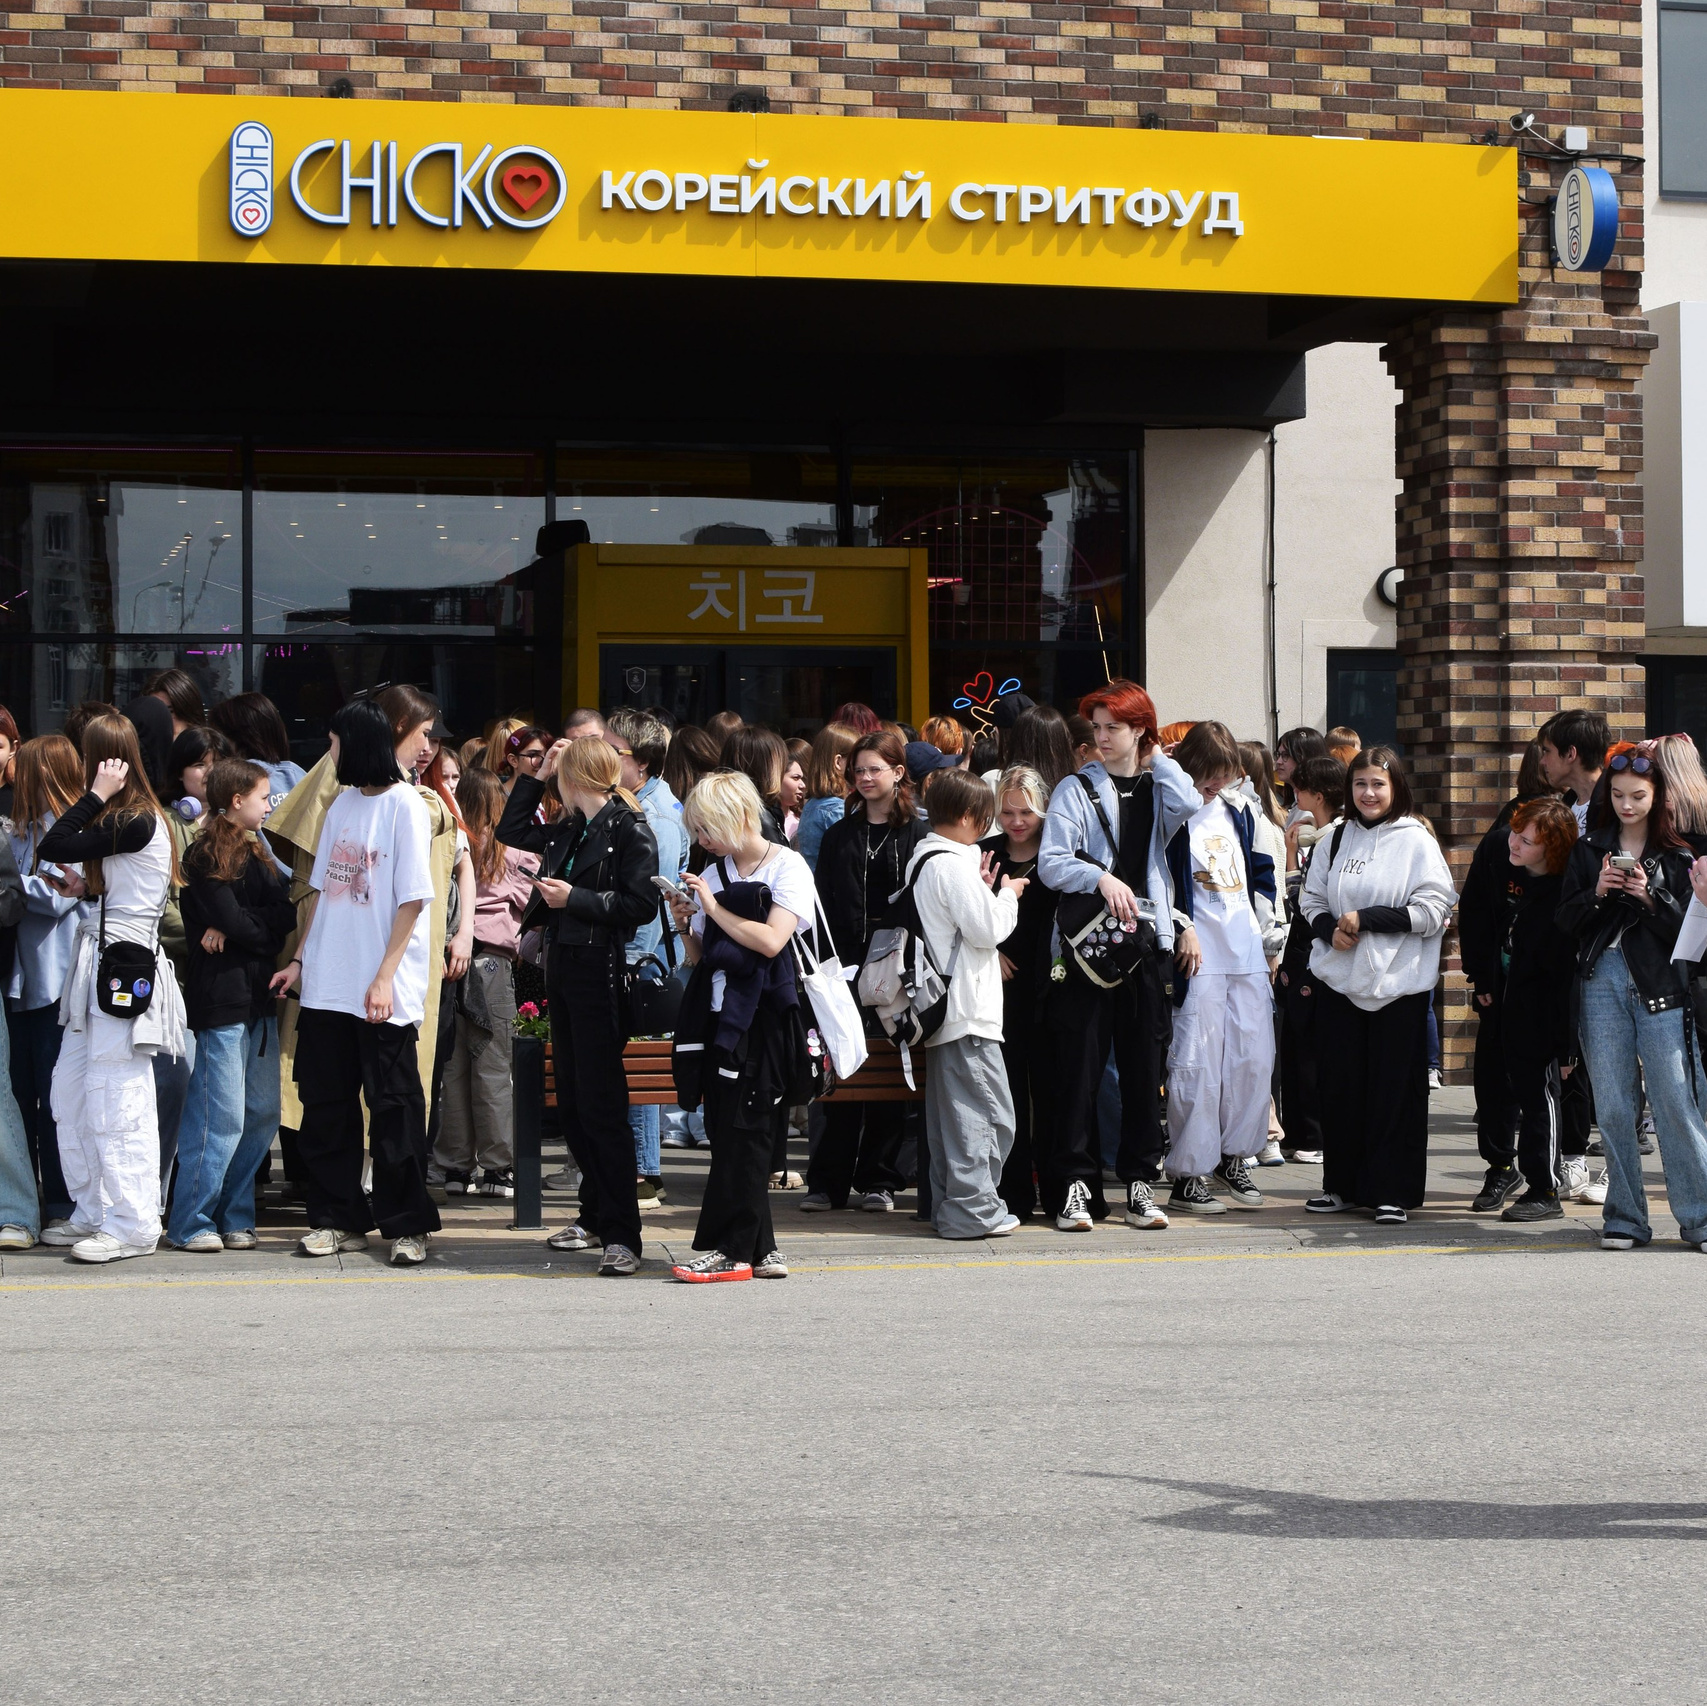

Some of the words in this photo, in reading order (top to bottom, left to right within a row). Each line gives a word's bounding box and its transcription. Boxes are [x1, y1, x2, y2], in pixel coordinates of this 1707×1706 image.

[235, 124, 269, 233] CHICKO
[289, 139, 568, 229] CHICKO
[600, 157, 932, 220] КОРЕЙСКИЙ
[948, 182, 1244, 237] СТРИТФУД
[1568, 176, 1580, 263] CHICKO
[686, 569, 824, 631] 치코
